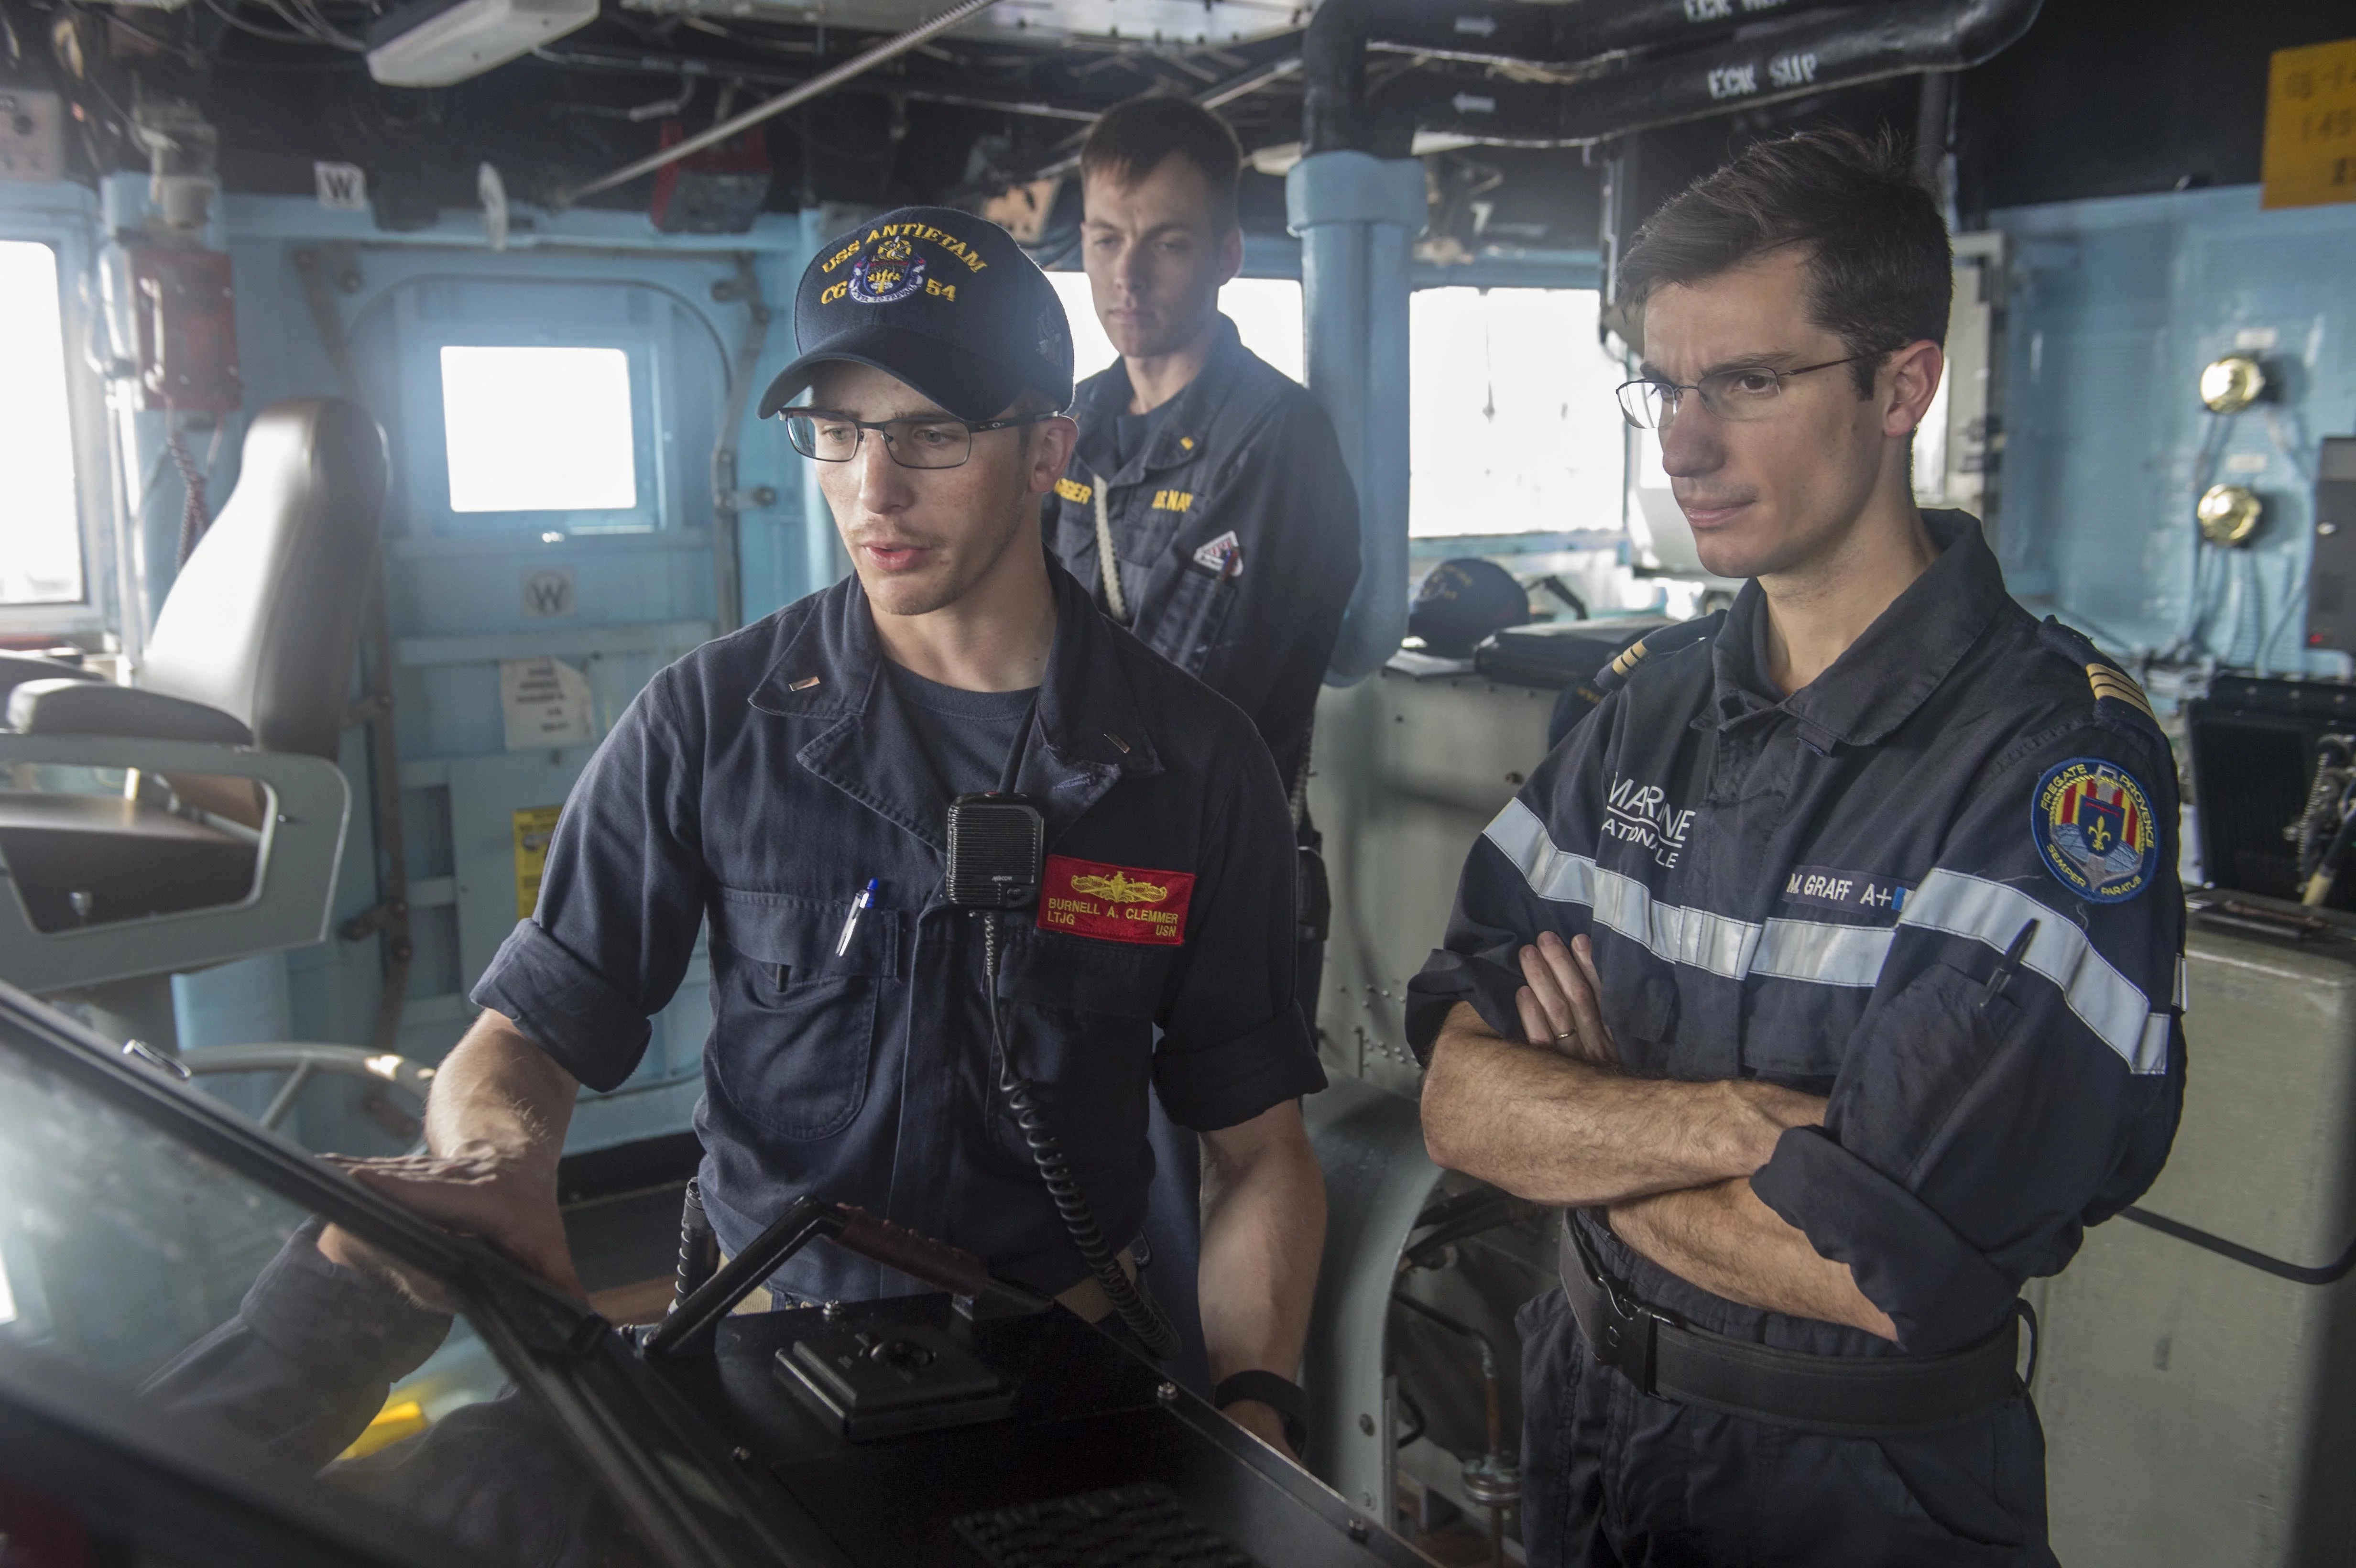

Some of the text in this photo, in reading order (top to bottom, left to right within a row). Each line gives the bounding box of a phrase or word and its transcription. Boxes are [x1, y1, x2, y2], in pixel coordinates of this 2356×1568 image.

[1769, 53, 1818, 87] SUP
[821, 222, 988, 273] USS ANTIETAM
[820, 280, 848, 305] CG
[926, 278, 956, 302] 54
[2040, 763, 2087, 811] FREGATE
[2120, 774, 2154, 848] PROVENCE
[2047, 844, 2086, 888] SEMPER
[1804, 874, 1853, 901] GRAFF
[1859, 883, 1892, 907] A+
[2101, 875, 2142, 896] PARATUS
[1047, 911, 1075, 926] LTJG
[1048, 898, 1178, 925] BURNELL A. CLEMMER
[1156, 925, 1177, 937] USN
